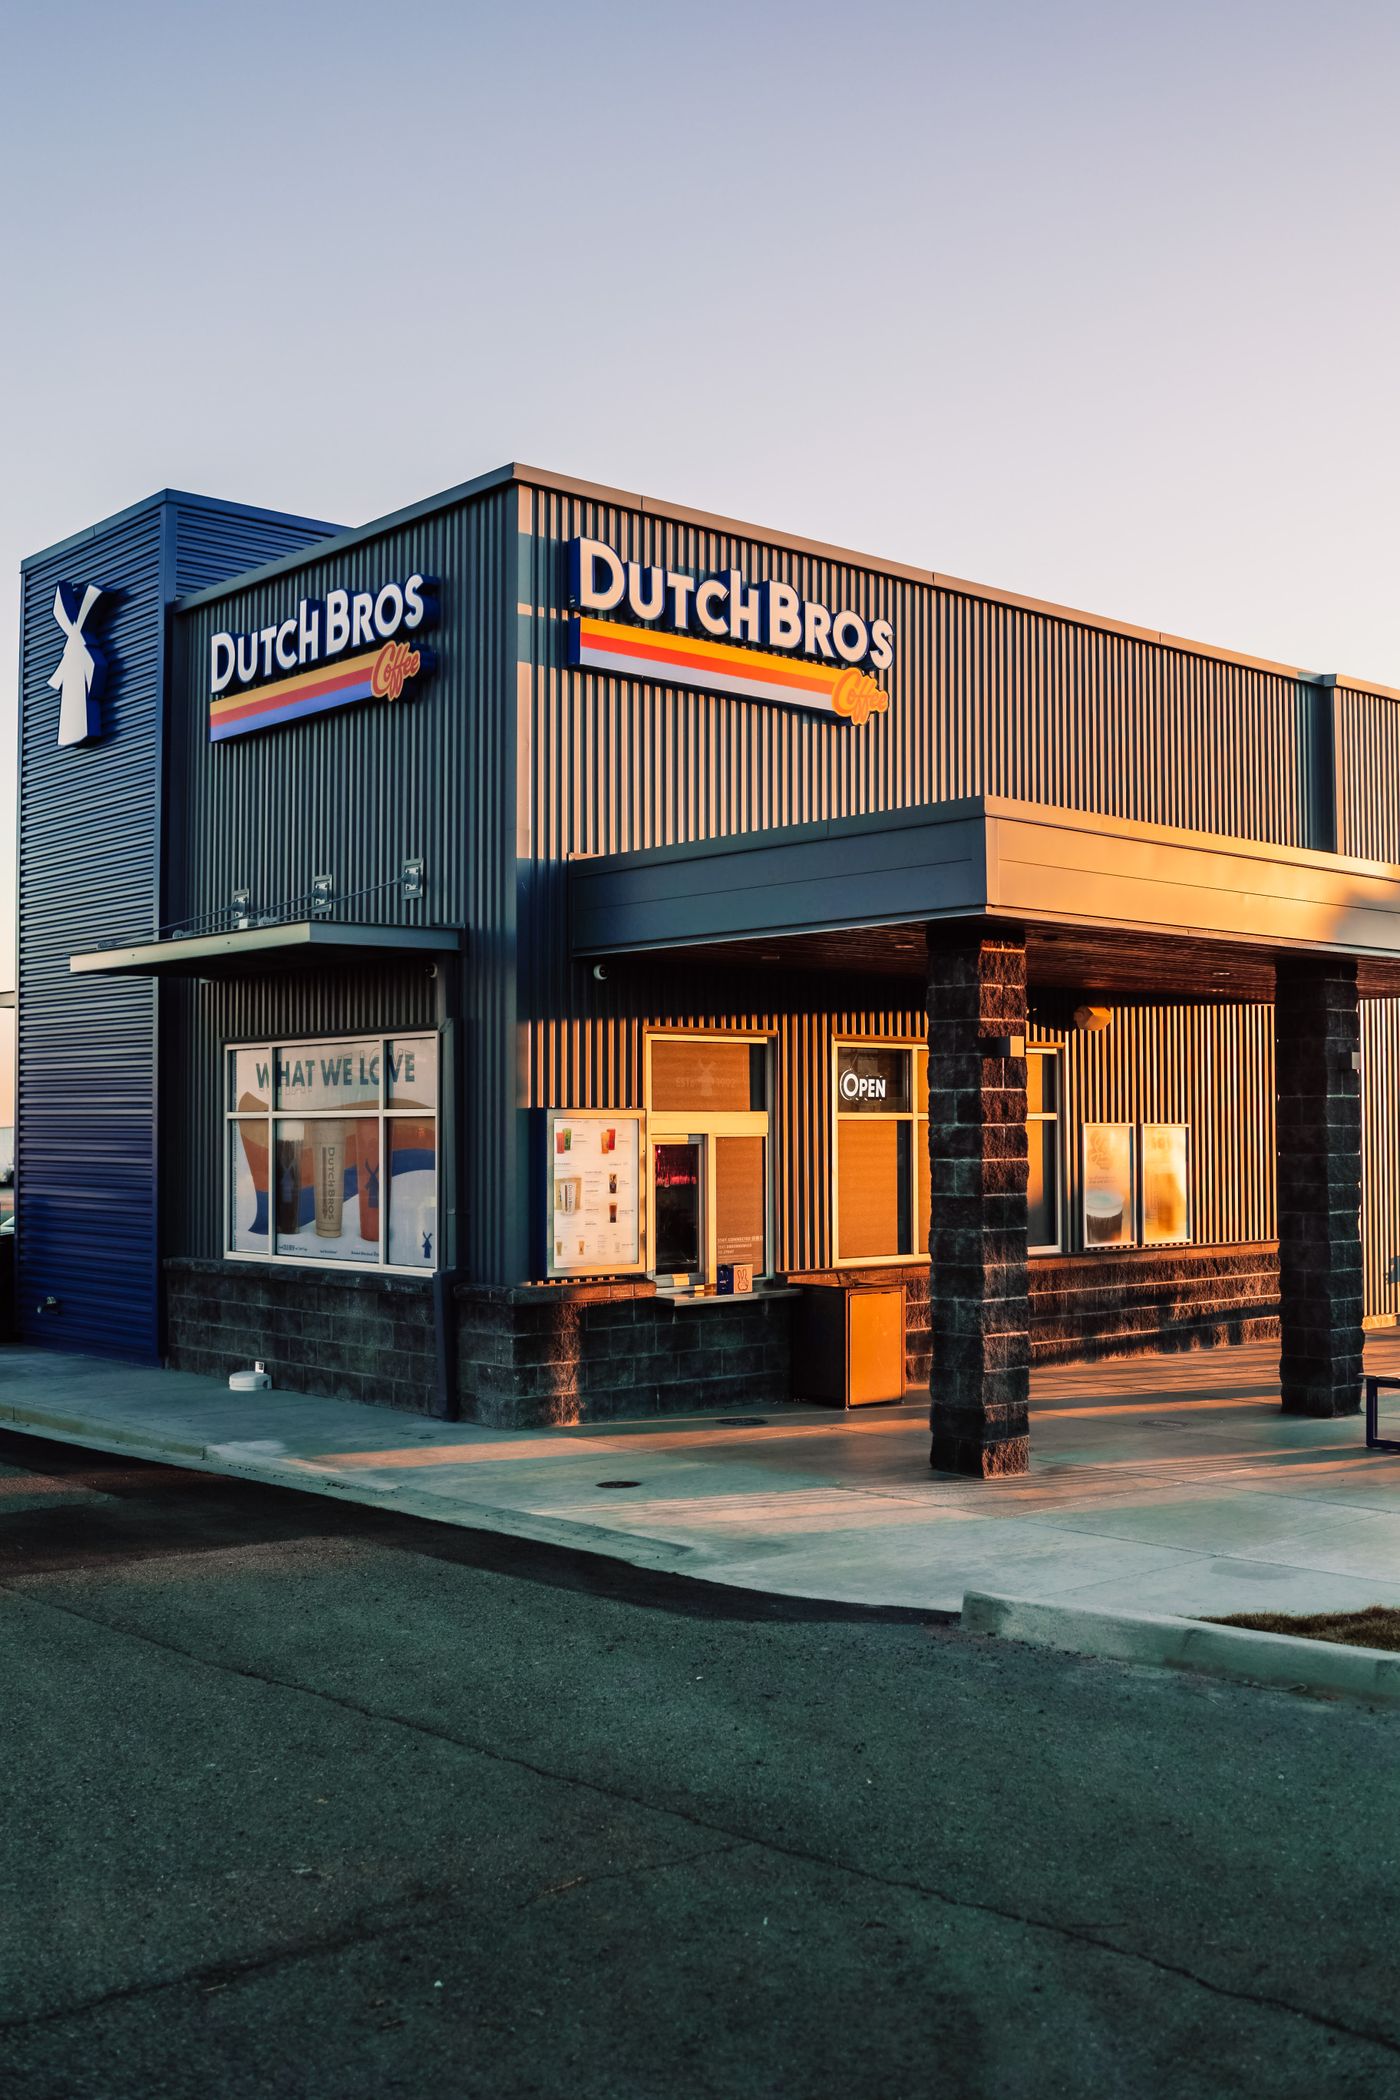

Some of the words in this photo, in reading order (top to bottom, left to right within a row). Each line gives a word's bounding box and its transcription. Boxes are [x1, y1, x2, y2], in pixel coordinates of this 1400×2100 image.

[580, 537, 760, 644] DUTCH
[768, 579, 895, 670] BROS
[210, 599, 319, 694] DUTCH
[325, 573, 424, 656] BROS
[373, 641, 420, 700] Coffee
[255, 1060, 315, 1089] WHAT
[320, 1058, 352, 1087] WE
[843, 1073, 886, 1098] OPEN
